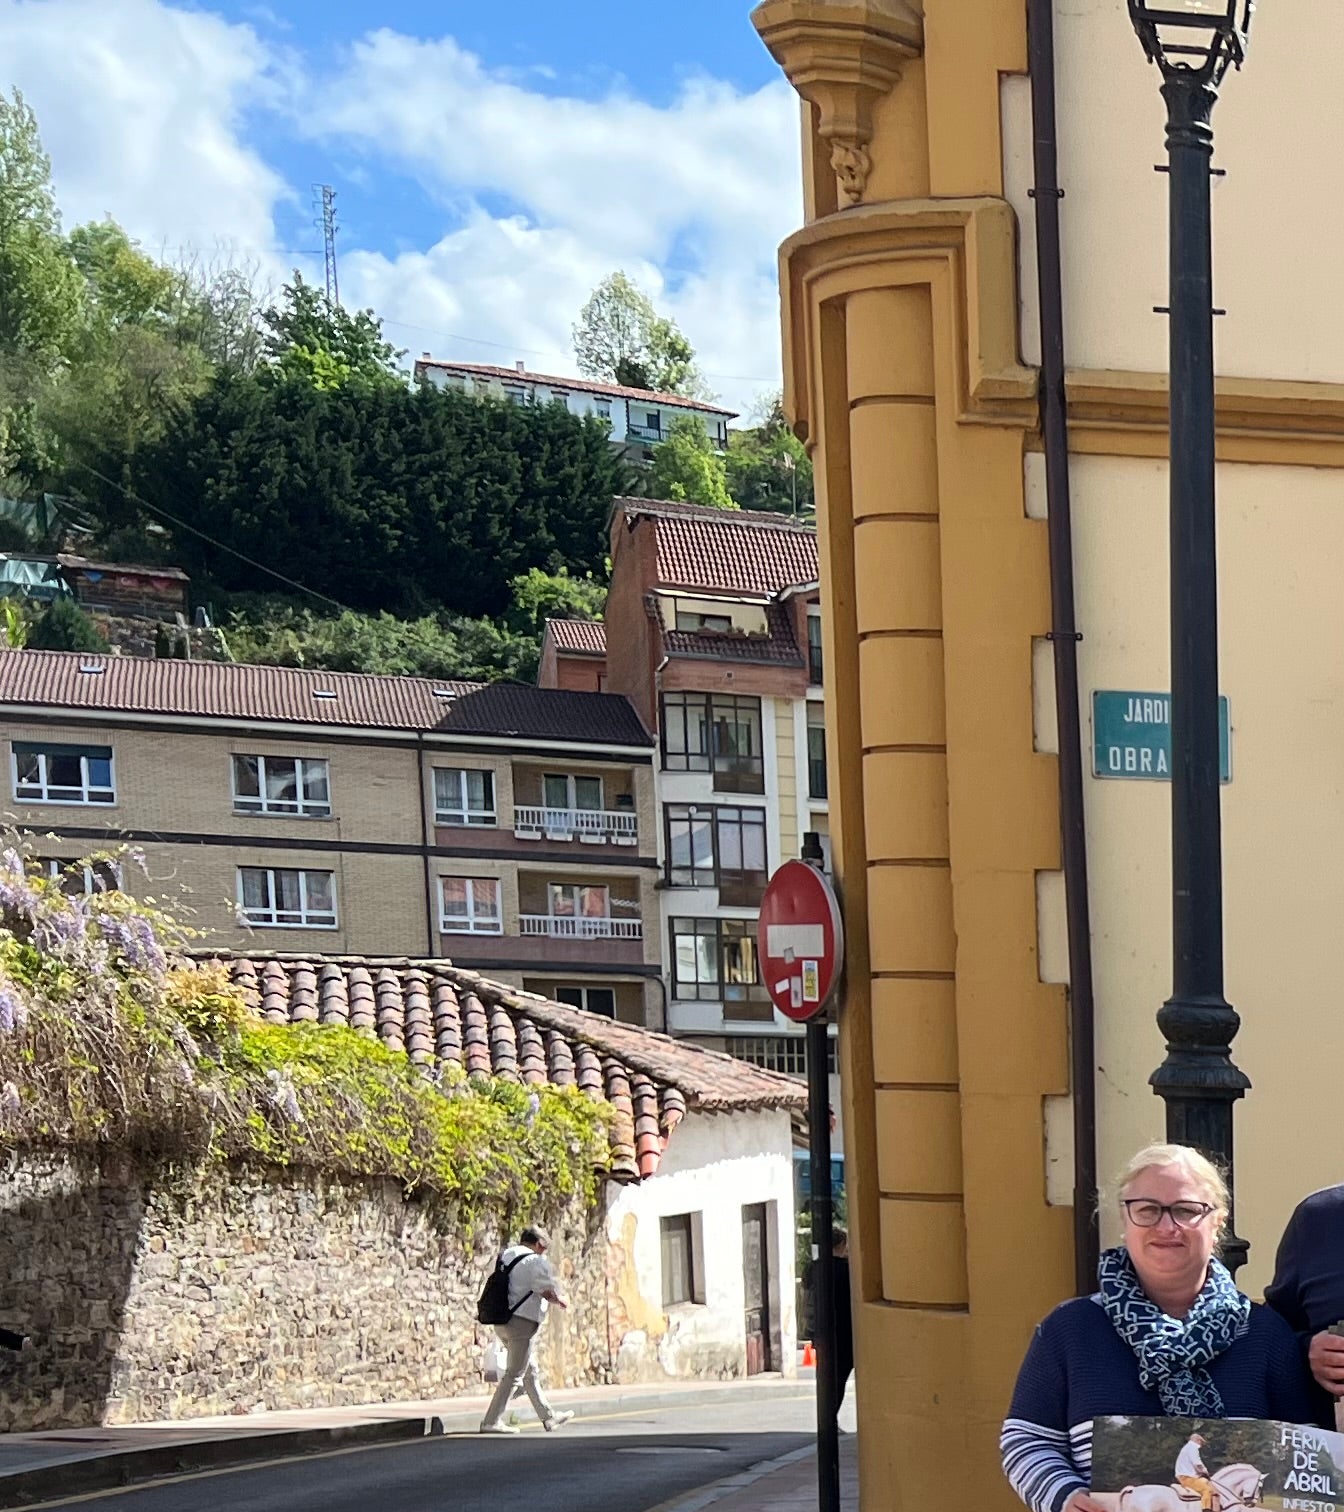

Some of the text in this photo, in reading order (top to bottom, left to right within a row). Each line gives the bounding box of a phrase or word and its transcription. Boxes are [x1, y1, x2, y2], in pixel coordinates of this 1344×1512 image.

[1123, 698, 1169, 724] JARDI
[1109, 746, 1168, 773] OBRA
[1281, 1428, 1330, 1453] FERIA
[1293, 1450, 1319, 1472] DE
[1283, 1470, 1336, 1496] ABRIL
